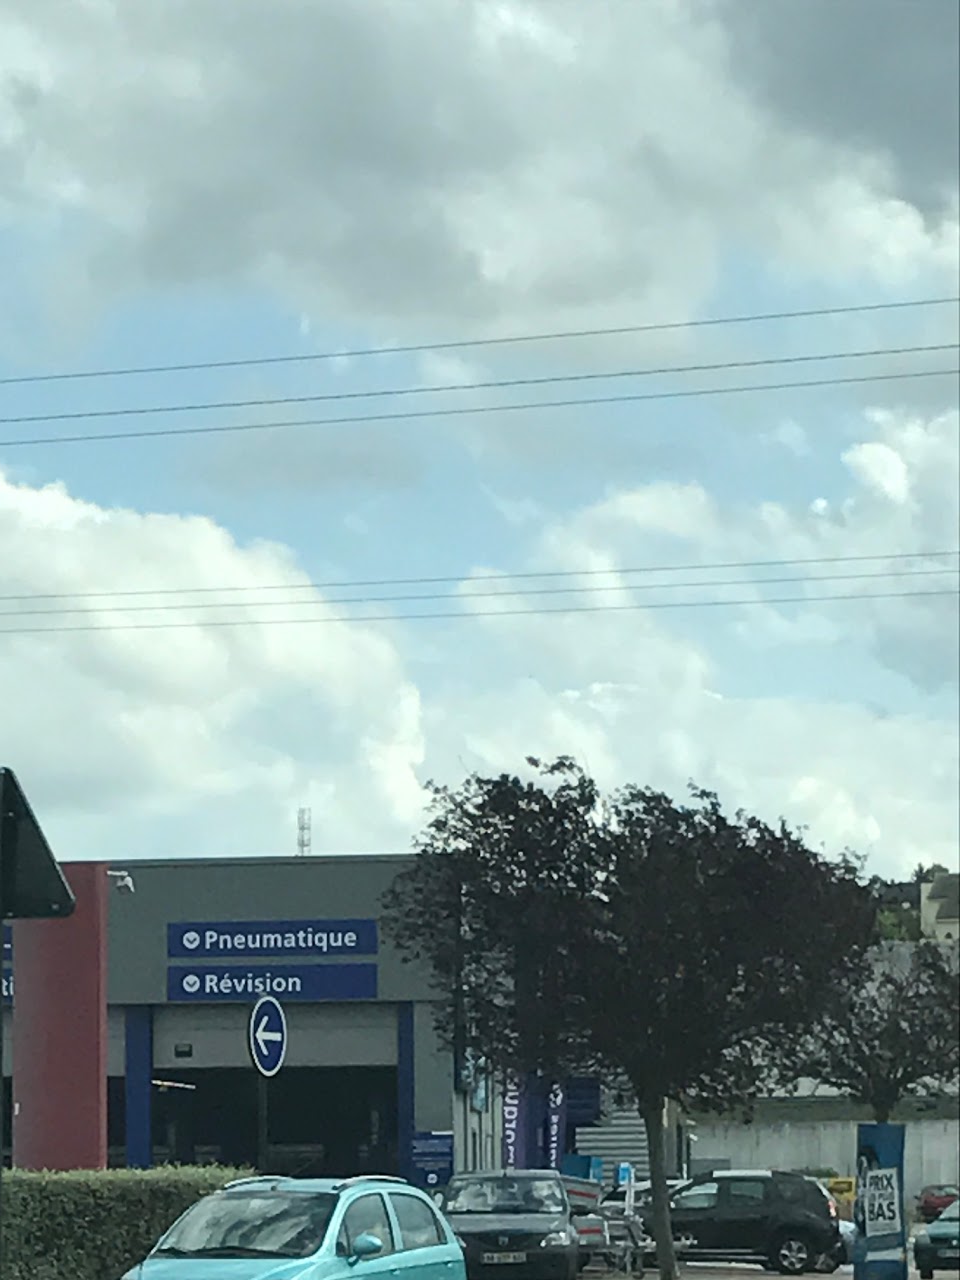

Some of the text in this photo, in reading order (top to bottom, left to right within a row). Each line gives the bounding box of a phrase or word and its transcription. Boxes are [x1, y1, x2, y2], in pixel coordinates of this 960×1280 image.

[204, 928, 357, 952] Pneumatique
[204, 973, 302, 994] Révision
[868, 1201, 897, 1221] BAS
